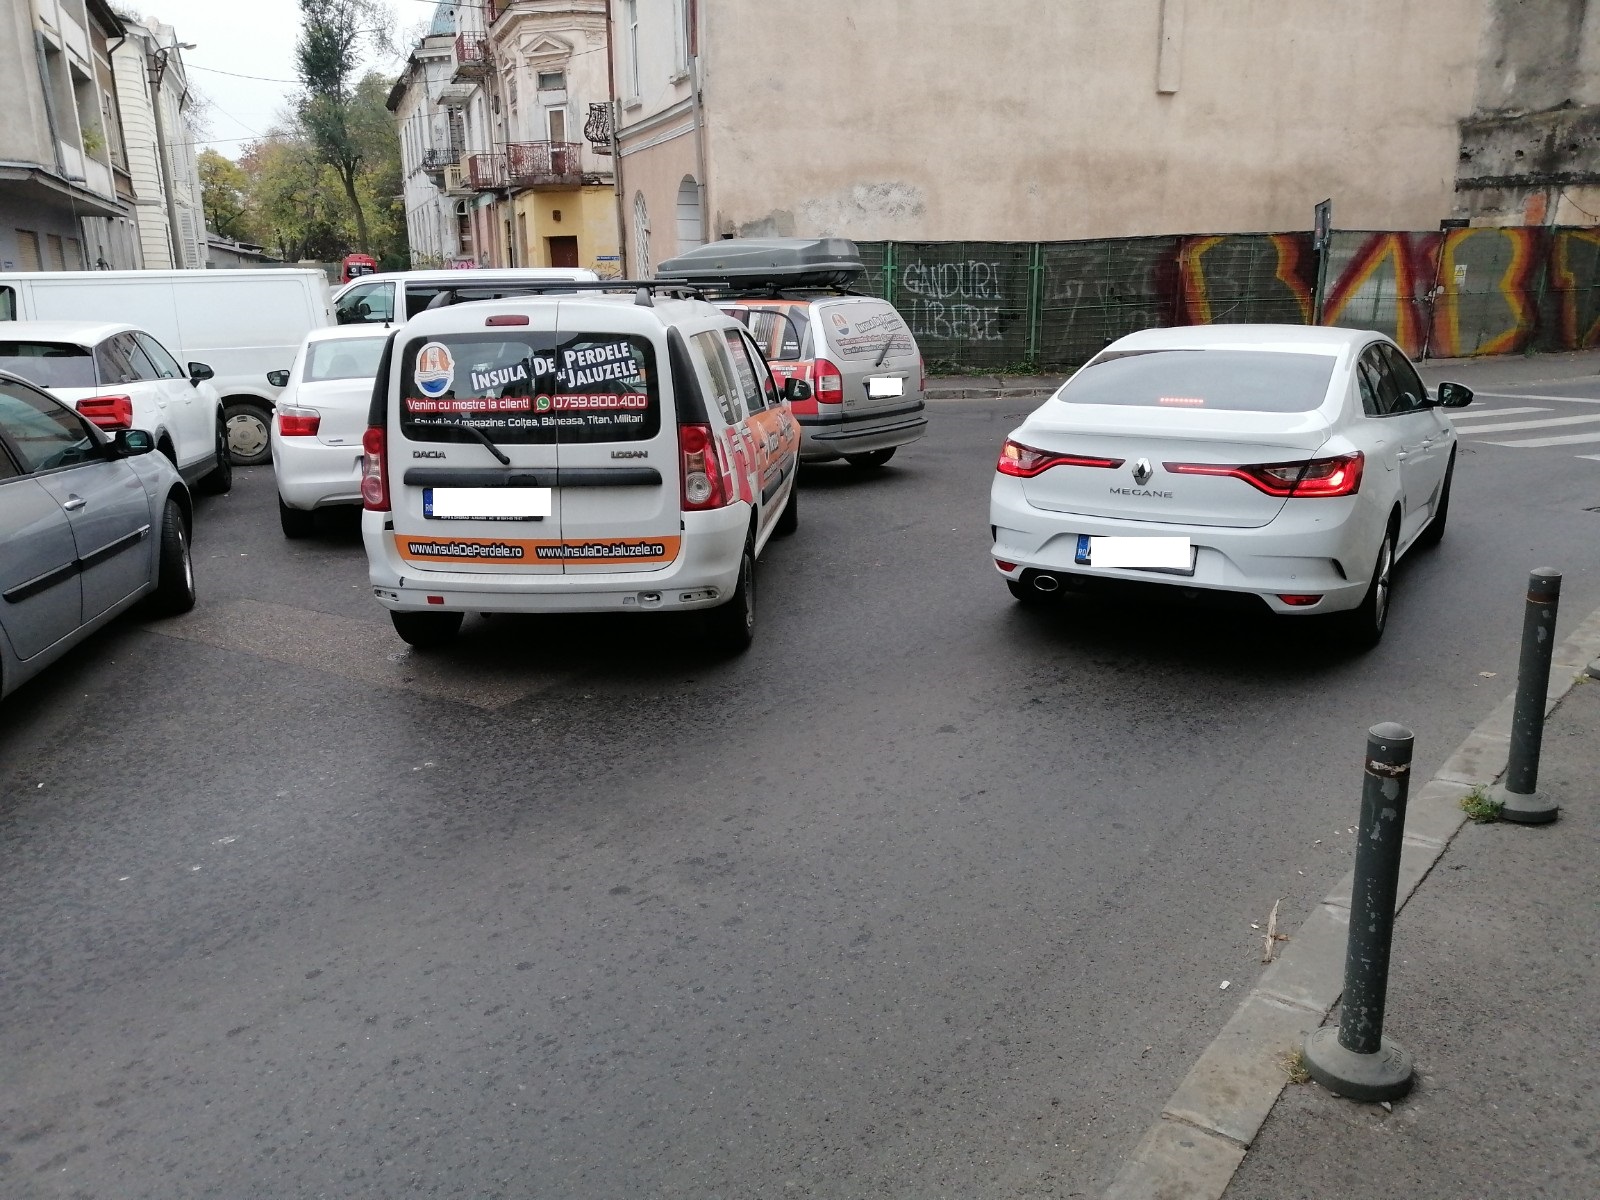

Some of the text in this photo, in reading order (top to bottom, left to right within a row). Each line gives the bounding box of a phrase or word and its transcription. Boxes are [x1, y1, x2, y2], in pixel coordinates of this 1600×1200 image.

[911, 298, 1003, 341] LIBERE
[471, 342, 630, 391] INSULA DE PERDELE
[567, 359, 638, 388] JALUZELE
[408, 398, 529, 410] Venim cu mostre la client!
[553, 395, 646, 408] 0759.800.400
[461, 418, 506, 427] magazine:
[586, 415, 613, 425] Titan,
[614, 413, 643, 424] Militari
[412, 450, 446, 459] DACIA
[610, 450, 648, 459] LOGAN
[1109, 487, 1173, 499] MEGANE
[409, 542, 523, 558] www.InsulaDePerdele.ro
[537, 543, 663, 557] www.InsulaDeJaluzele.ro
[1077, 548, 1087, 557] RO
